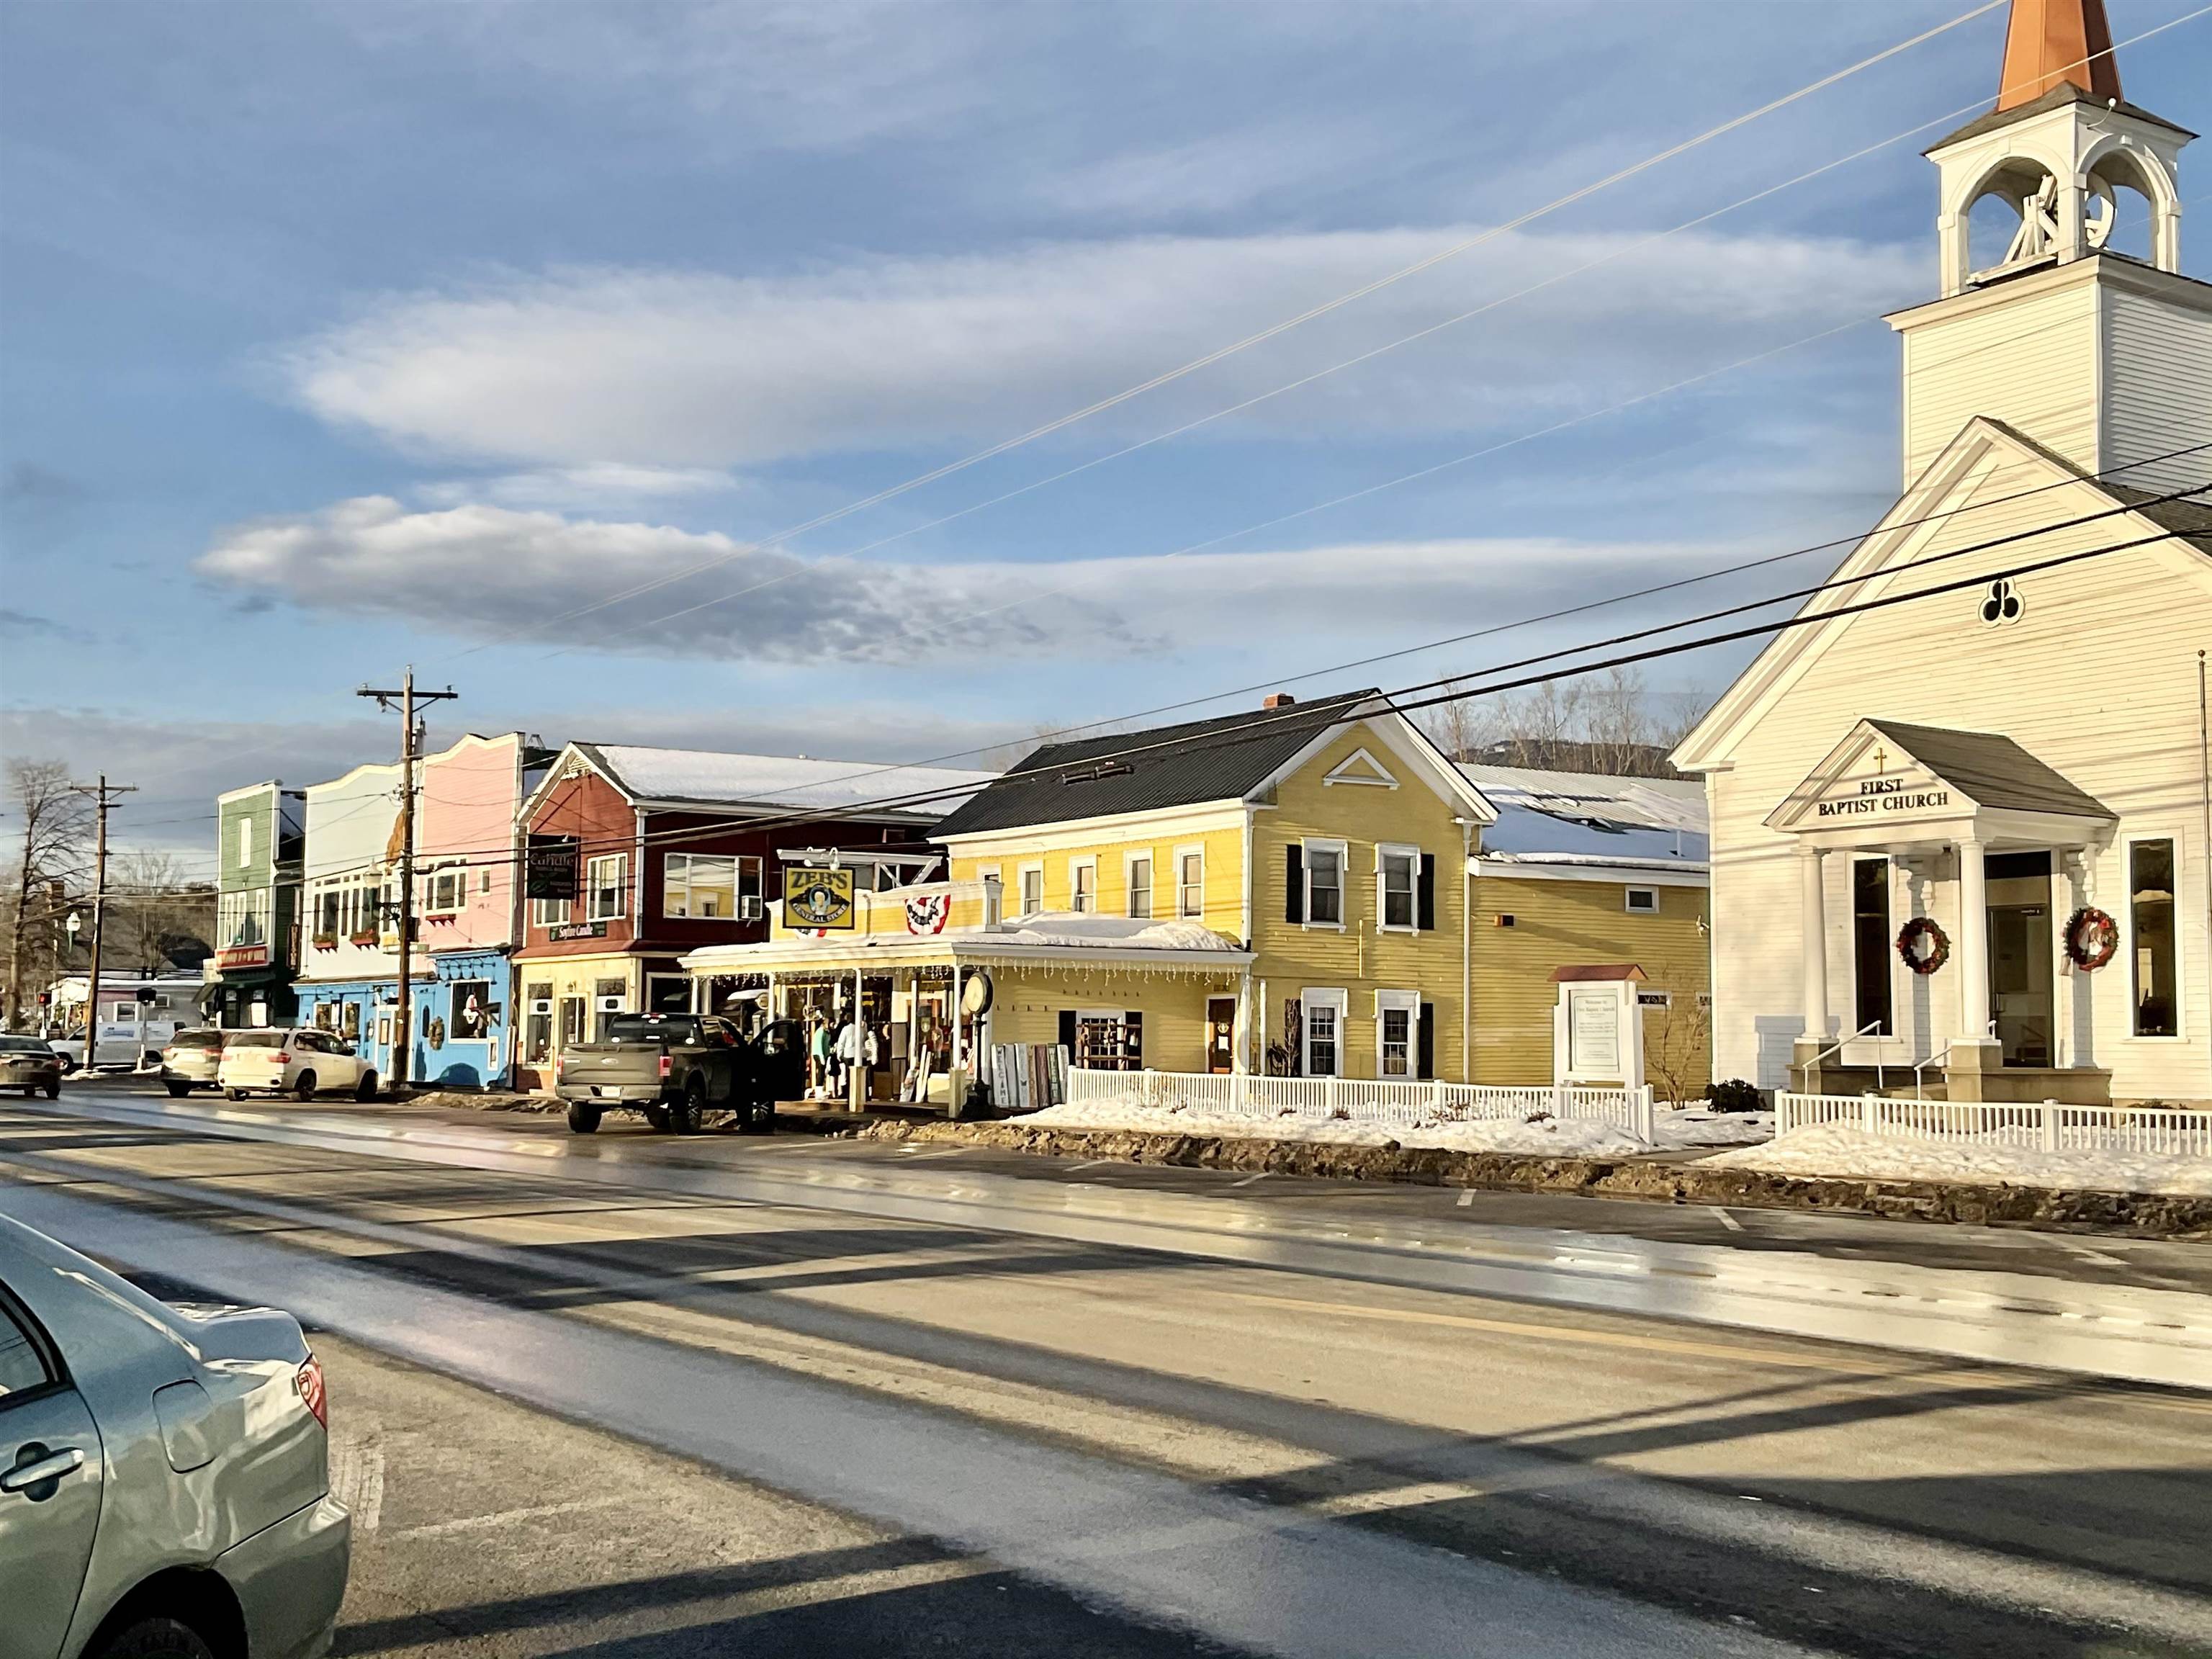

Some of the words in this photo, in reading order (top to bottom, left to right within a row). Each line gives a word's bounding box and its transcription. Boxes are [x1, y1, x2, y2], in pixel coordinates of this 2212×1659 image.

[1860, 778, 1903, 795] FIRST
[1818, 799, 1878, 816] BAPTIST
[1882, 792, 1948, 811] CHURCH
[790, 871, 848, 889] ZEB'S
[792, 902, 825, 922] GENERAL
[826, 903, 848, 922] STORE
